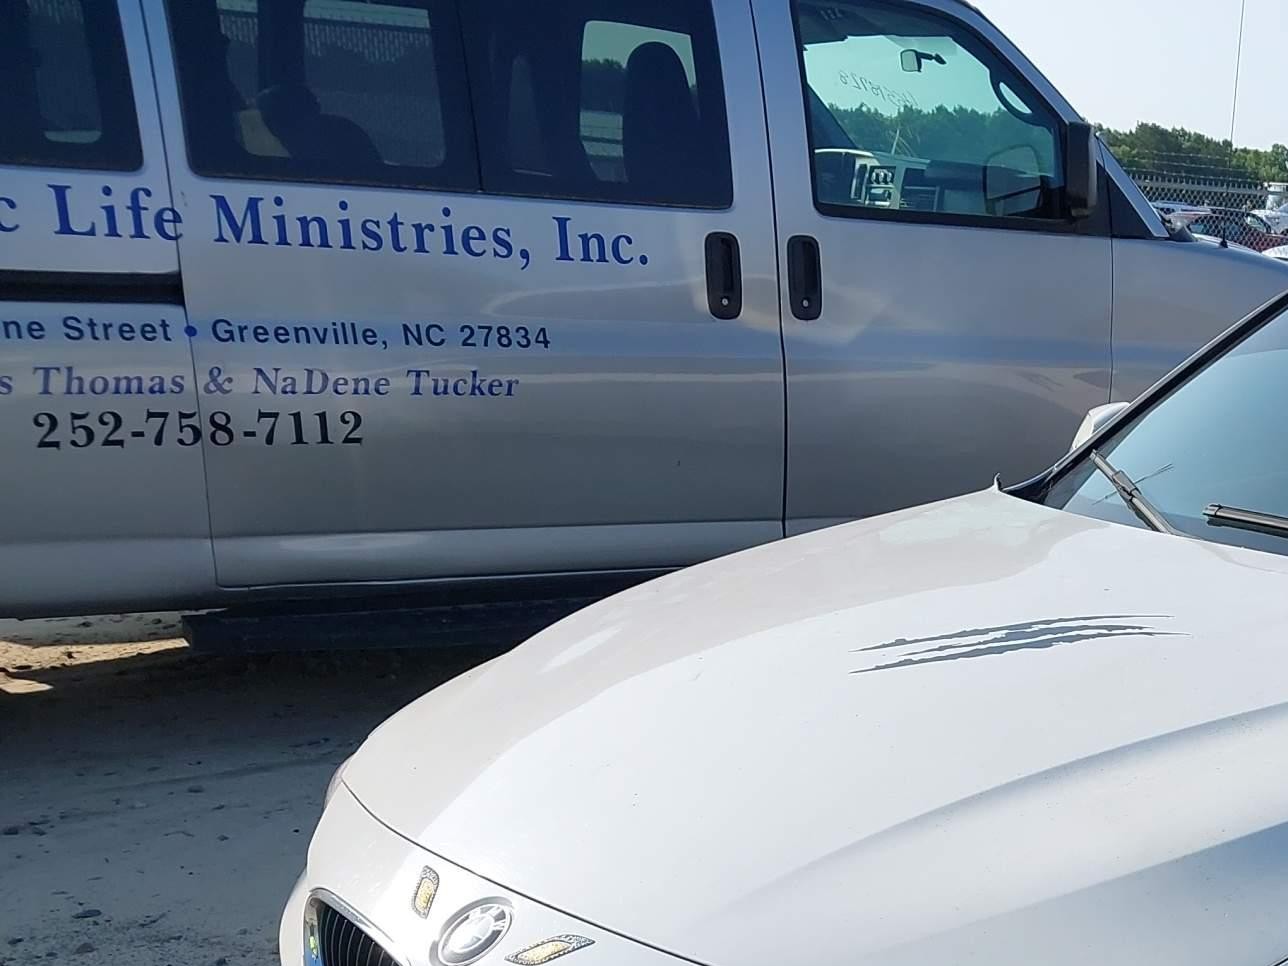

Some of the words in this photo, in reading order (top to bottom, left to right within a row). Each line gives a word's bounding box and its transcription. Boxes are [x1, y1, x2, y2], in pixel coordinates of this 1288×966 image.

[47, 184, 183, 241] Life
[209, 194, 530, 270] Ministries,
[552, 216, 649, 265] Inc.
[62, 316, 172, 342] Street
[211, 318, 388, 350] Greenville,
[402, 323, 446, 347] NC
[459, 324, 550, 351] 27834
[32, 366, 185, 396] Thomas
[203, 366, 234, 395] &
[251, 367, 391, 396] NaDene
[406, 368, 519, 397] Tucker
[32, 408, 363, 450] 252-758-7112
